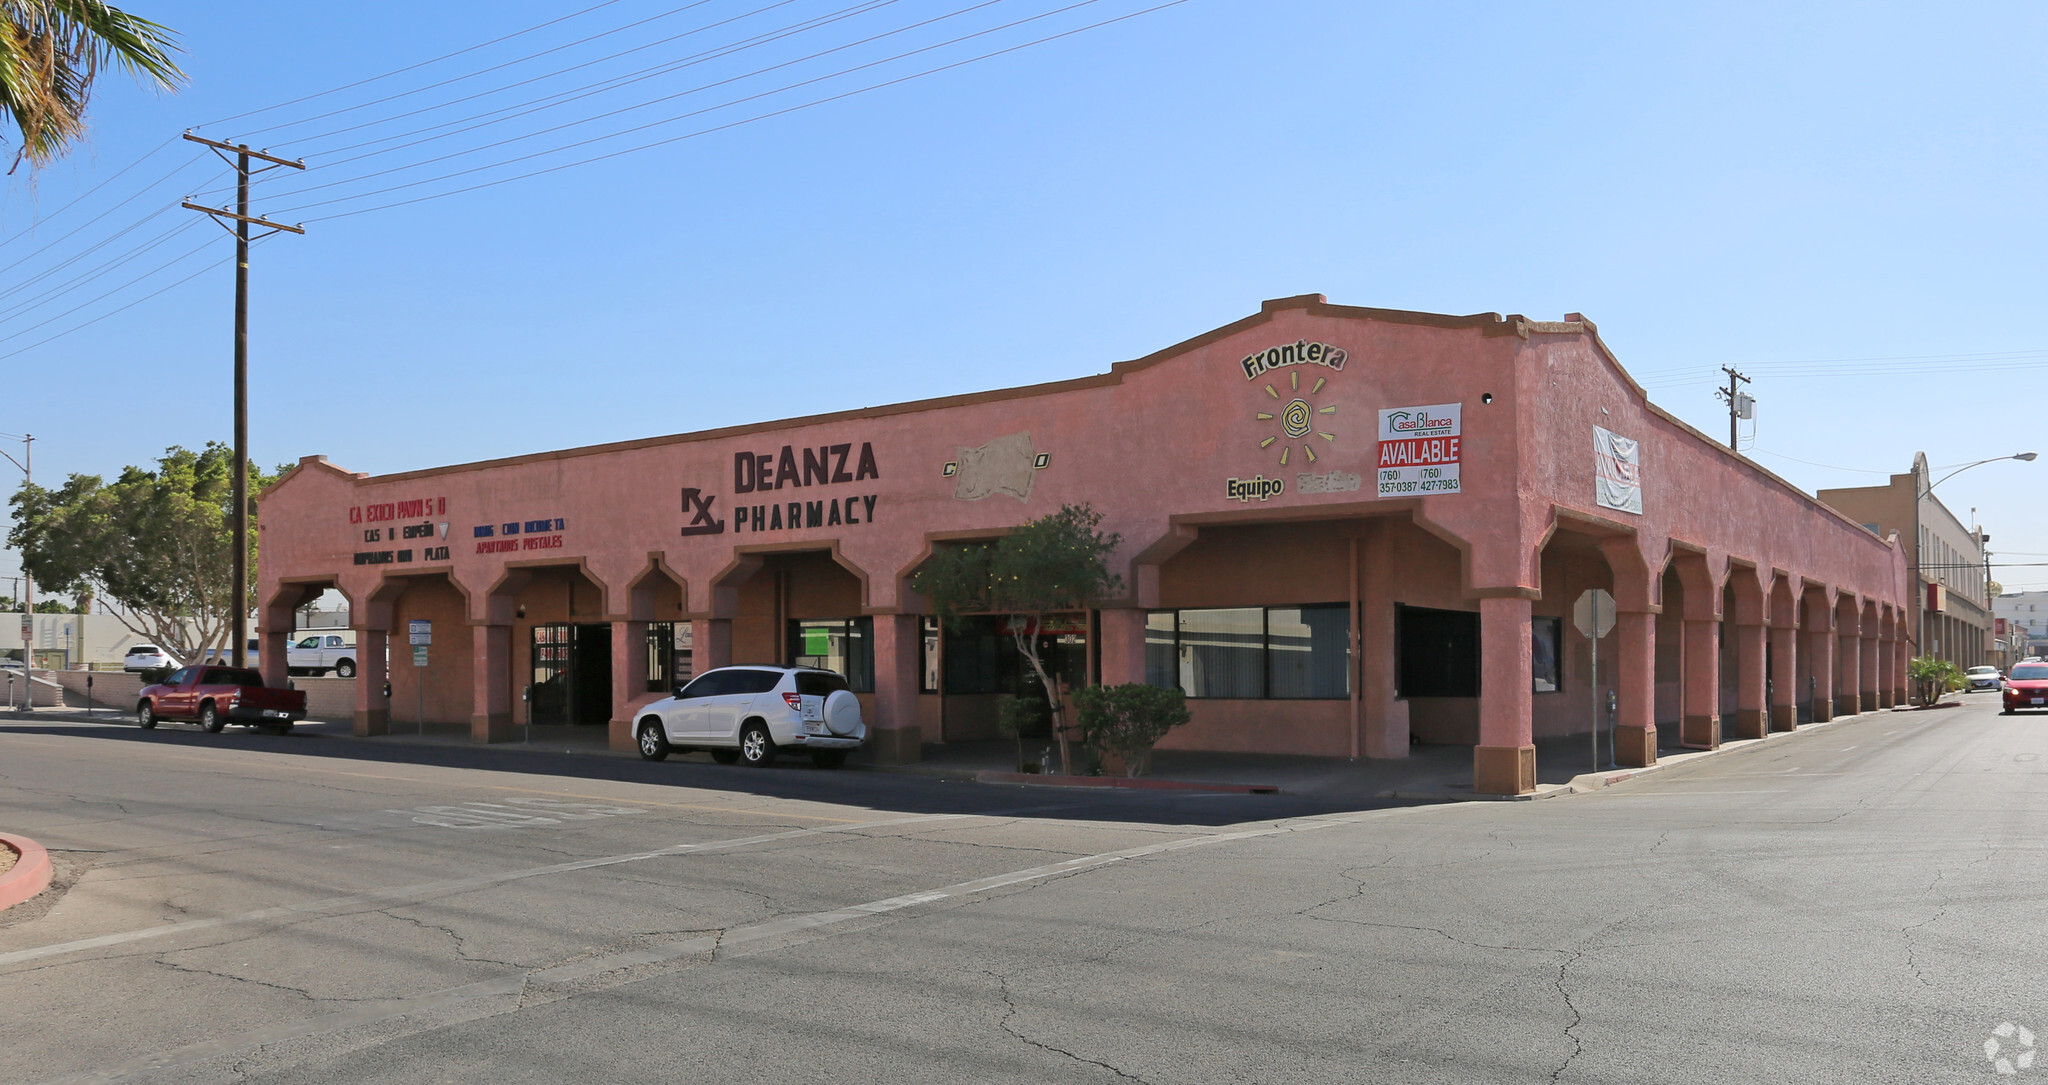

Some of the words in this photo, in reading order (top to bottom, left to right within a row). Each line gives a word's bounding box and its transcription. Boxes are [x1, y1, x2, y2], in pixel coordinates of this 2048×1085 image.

[1241, 339, 1348, 380] Frontera
[1380, 438, 1459, 466] AVAILABLE
[1380, 470, 1401, 481] (760)
[1420, 468, 1442, 479] (760)
[1227, 475, 1284, 501] Equipo
[1379, 482, 1418, 493] 357-0387
[1420, 479, 1459, 491] 427-7983
[735, 495, 878, 533] PHARMACY
[425, 546, 450, 561] PLATA
